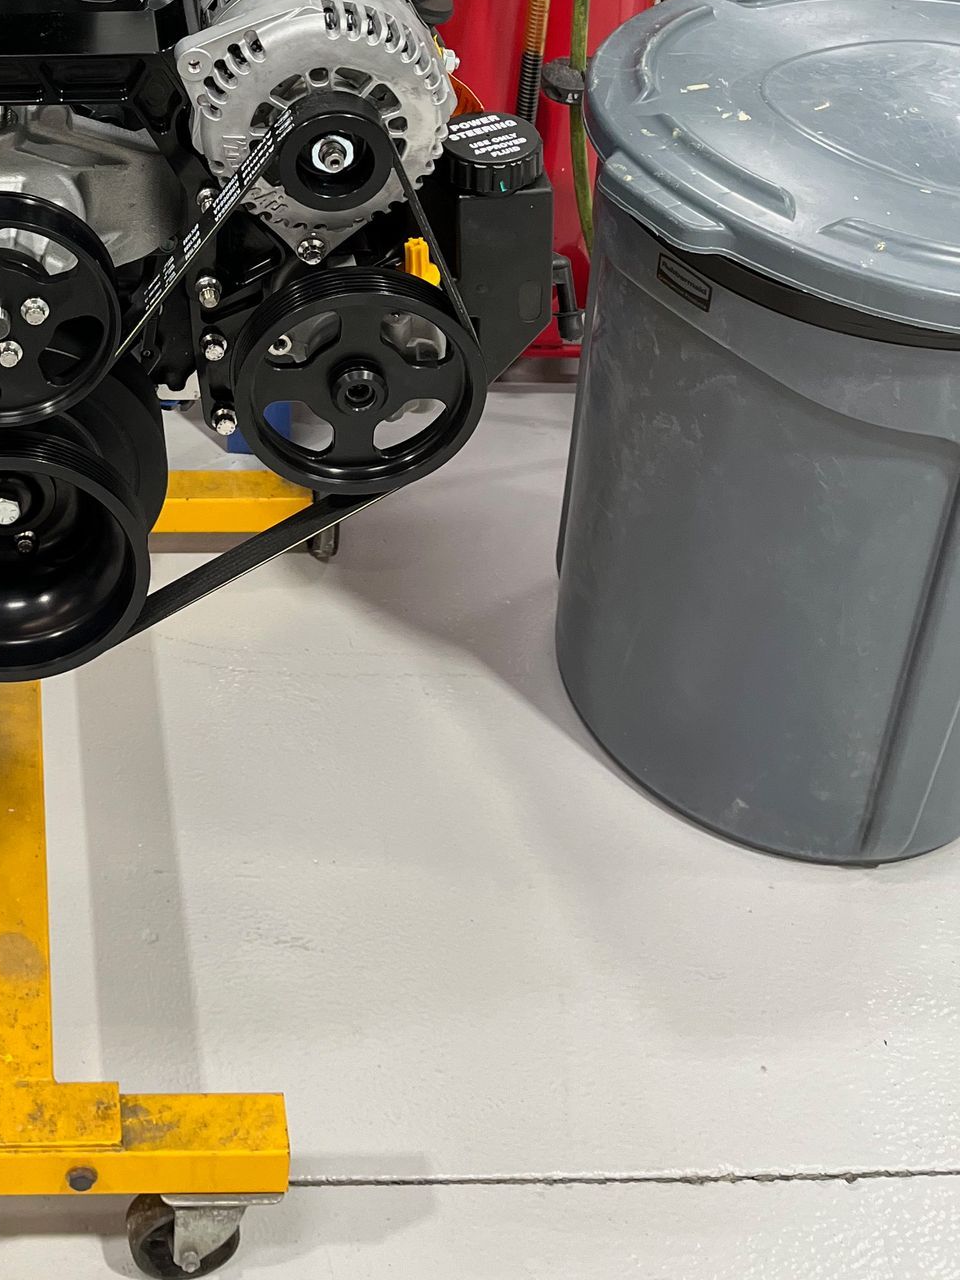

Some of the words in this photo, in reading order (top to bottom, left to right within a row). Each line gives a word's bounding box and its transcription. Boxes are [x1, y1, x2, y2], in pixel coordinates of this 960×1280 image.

[448, 114, 500, 132] POWER
[448, 119, 518, 141] STEERING
[468, 139, 491, 149] USE
[491, 132, 518, 143] ONLY
[473, 137, 527, 155] APPROVED
[490, 146, 521, 158] FLUID
[662, 261, 707, 296] Rubbermaid
